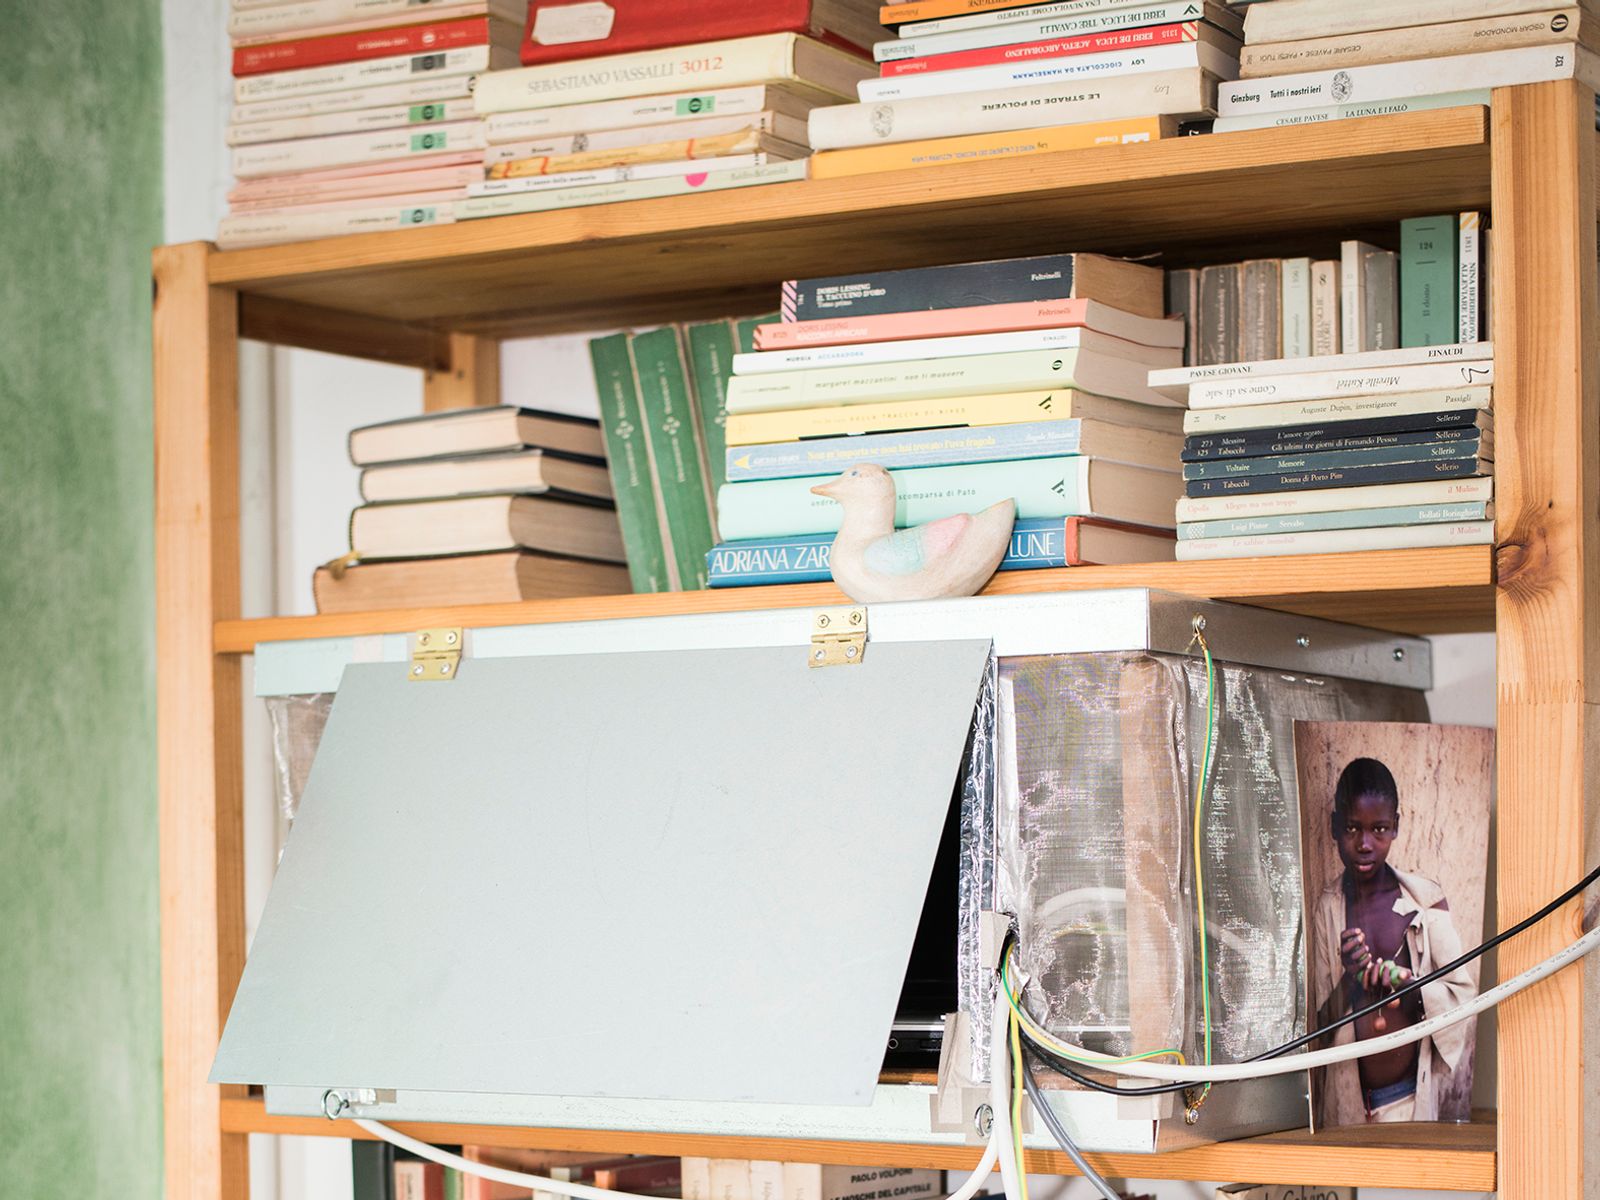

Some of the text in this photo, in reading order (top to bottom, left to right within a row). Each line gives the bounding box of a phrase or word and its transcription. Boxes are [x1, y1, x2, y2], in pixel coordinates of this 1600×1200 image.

[1039, 9, 1166, 34] ERRI DE LUCA TRE CAVALLI
[1473, 22, 1545, 38] OSCAR MONDADORI
[1095, 32, 1153, 46] ERRI DE LUCA
[1305, 44, 1361, 59] CESARE PAVESE
[1012, 68, 1062, 79] HANSELMANN
[1076, 61, 1122, 72] CIOCCOLATA
[527, 57, 724, 93] SEBASTIANO VASSALLI 3012
[1044, 94, 1085, 105] STRADE
[1231, 87, 1309, 104] Ginzburg Tutti nostri
[981, 100, 1028, 111] POLVERE
[1275, 115, 1302, 125] CESARE
[1345, 108, 1376, 118] LA LUNA
[1418, 241, 1434, 250] 124
[1031, 271, 1061, 282] Feltrinelli
[1422, 284, 1431, 306] dono
[1460, 263, 1469, 327] ALLEVIARE LA
[1468, 262, 1477, 341] NINA BERBEROVA
[1428, 347, 1464, 358] EINAUDI
[1189, 365, 1252, 378] PAVESE GIOVANE
[1367, 376, 1400, 388] Mireille
[1248, 384, 1276, 396] Come
[1301, 393, 1472, 415] Auguste investigatore Passigli
[1221, 413, 1461, 446] Messina L'amore Sellerio
[1218, 430, 1461, 456] Tabucchi ultimi tre giorni di Fernando Pessoa Sellerio
[1225, 447, 1456, 473] Voltaire Memorie Sellerio
[1202, 462, 1460, 490] 71 Tabucchi Donna di Porto Pim Sellerio
[899, 489, 955, 501] scomparsa di
[1455, 484, 1479, 493] Mulino
[1419, 507, 1481, 519] Bollati Boringhieri
[1009, 532, 1056, 558] LUNE
[711, 550, 789, 573] ADRIANA
[850, 1172, 877, 1184] PAOLO
[877, 1190, 893, 1200] DEL
[895, 1183, 932, 1198] CAPITALE
